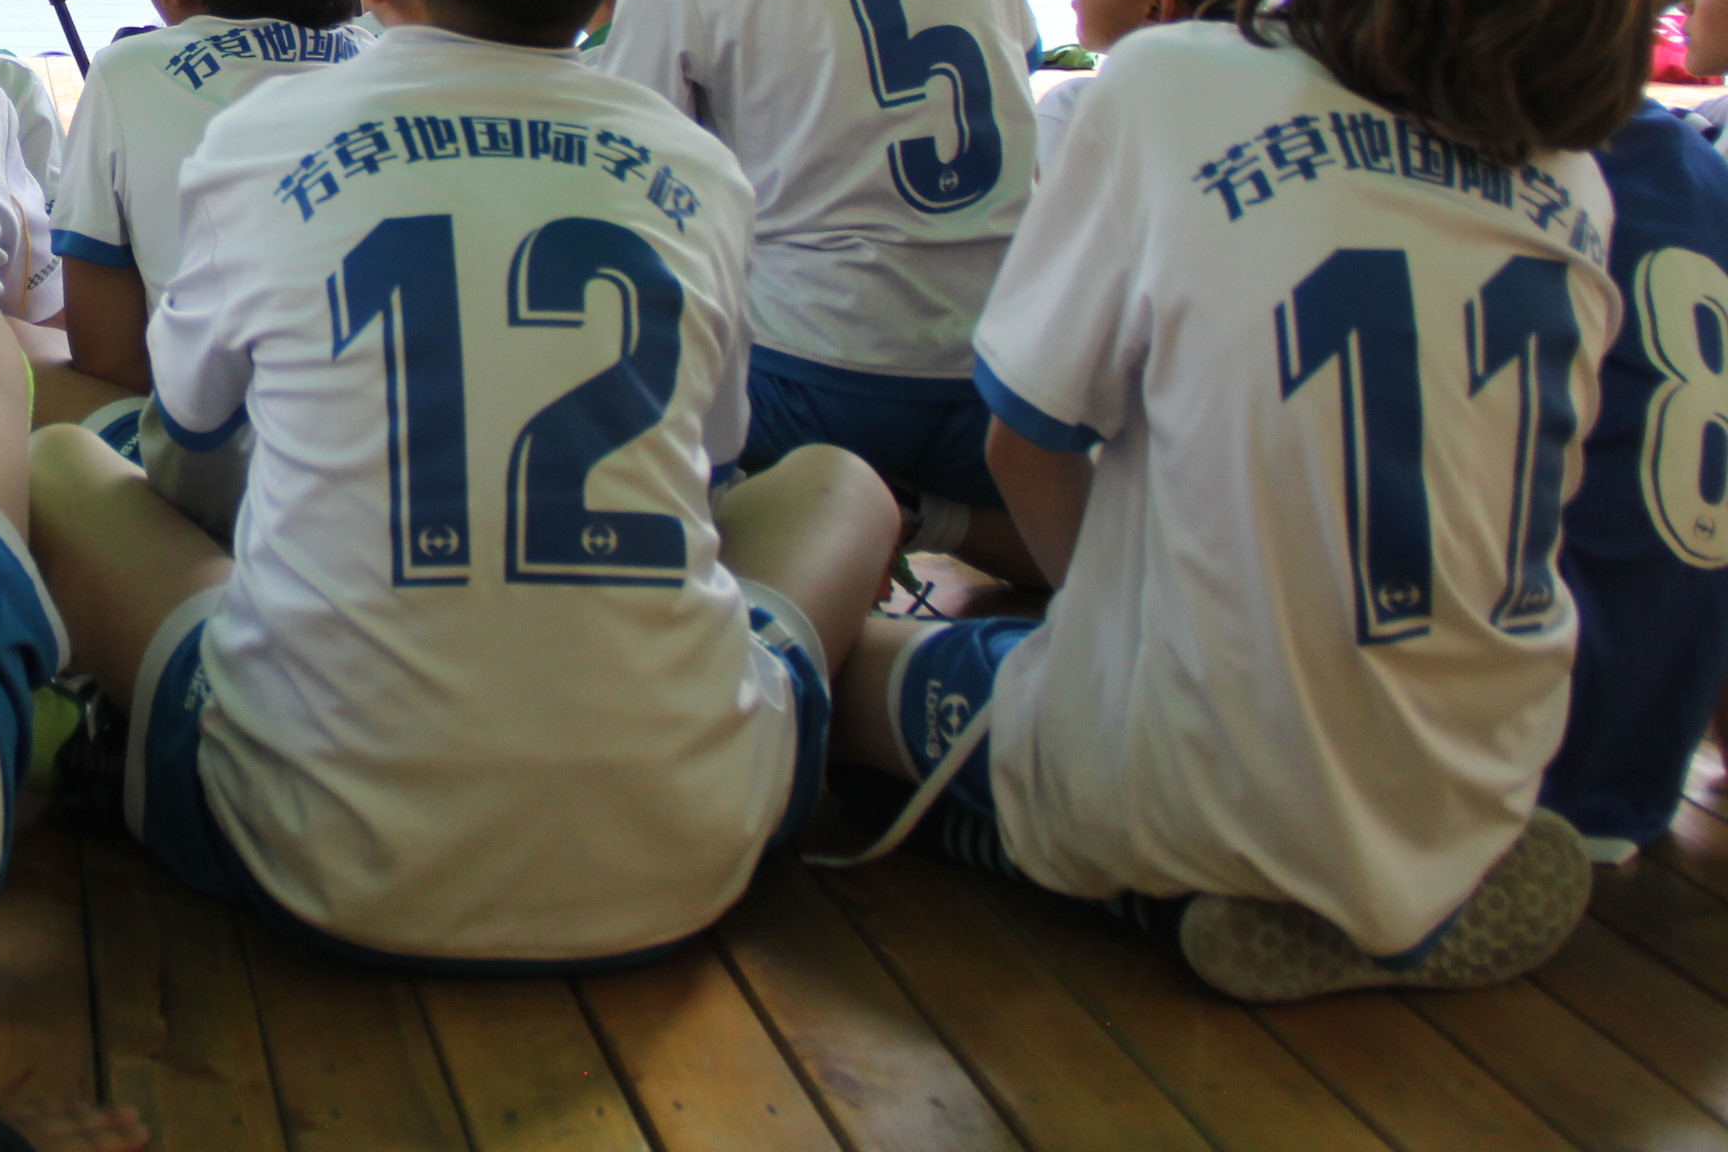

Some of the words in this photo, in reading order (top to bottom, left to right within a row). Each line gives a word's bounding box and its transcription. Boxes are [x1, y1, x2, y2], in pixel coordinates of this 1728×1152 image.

[273, 115, 702, 233] 芳草地国际学校
[327, 214, 687, 588] 12
[1276, 248, 1584, 647] 11
[1633, 247, 1728, 571] 8
